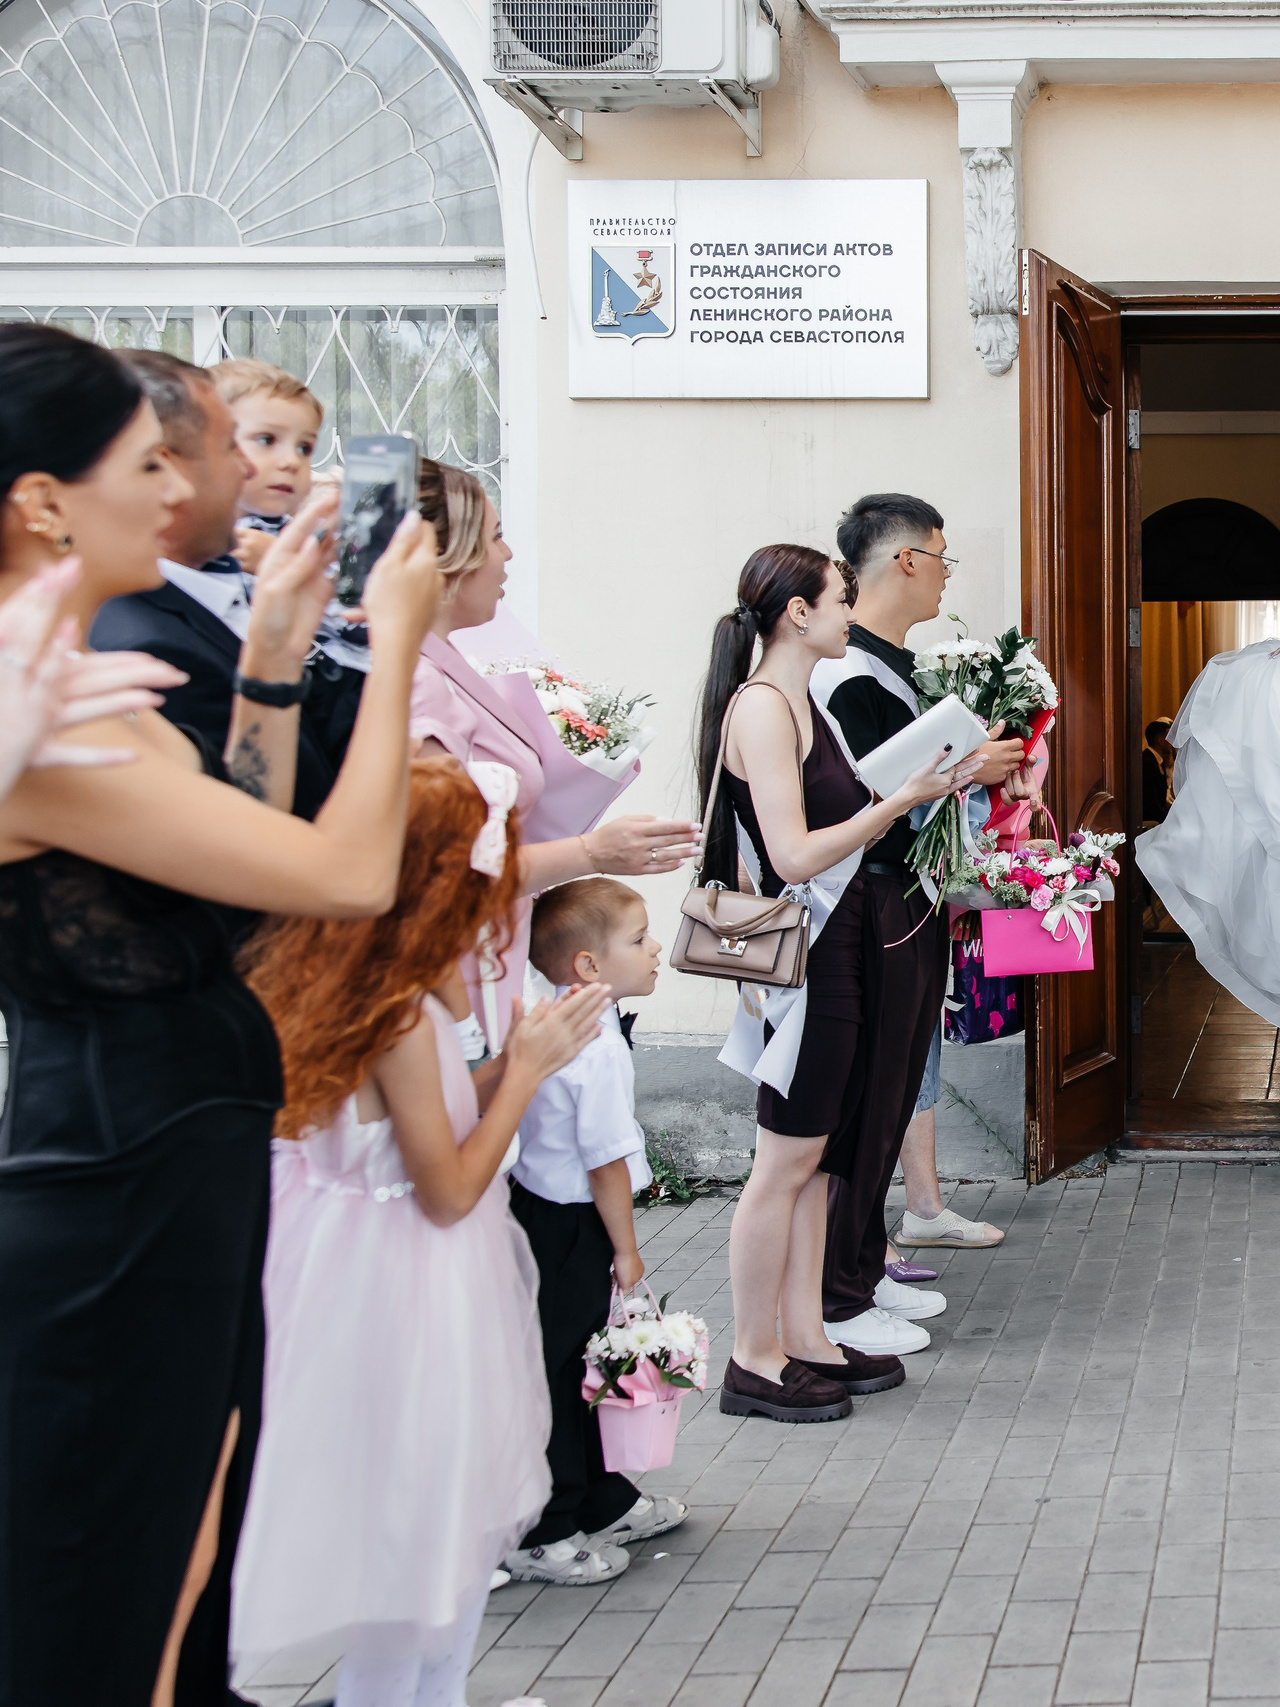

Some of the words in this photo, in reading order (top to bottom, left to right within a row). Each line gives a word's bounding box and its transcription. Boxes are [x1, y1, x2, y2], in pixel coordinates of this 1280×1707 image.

[589, 217, 676, 226] ПРАВИТЕЛЬСТВО
[592, 227, 671, 236] СЕВАСТОПОЛЯ
[689, 242, 749, 258] ОТДЕЛ
[754, 242, 828, 257] ЗАПИСИ
[833, 242, 894, 257] АКТОВ
[689, 264, 841, 279] ГРАЖДАНСКОГО
[689, 286, 803, 300] СОСТОЯНИЯ
[689, 308, 813, 322] ЛЕНИНСКОГО
[818, 305, 893, 322] РАЙОНА
[690, 330, 765, 345] ГОРОДА
[769, 330, 905, 344] СЕВАСТОПОЛЯ
